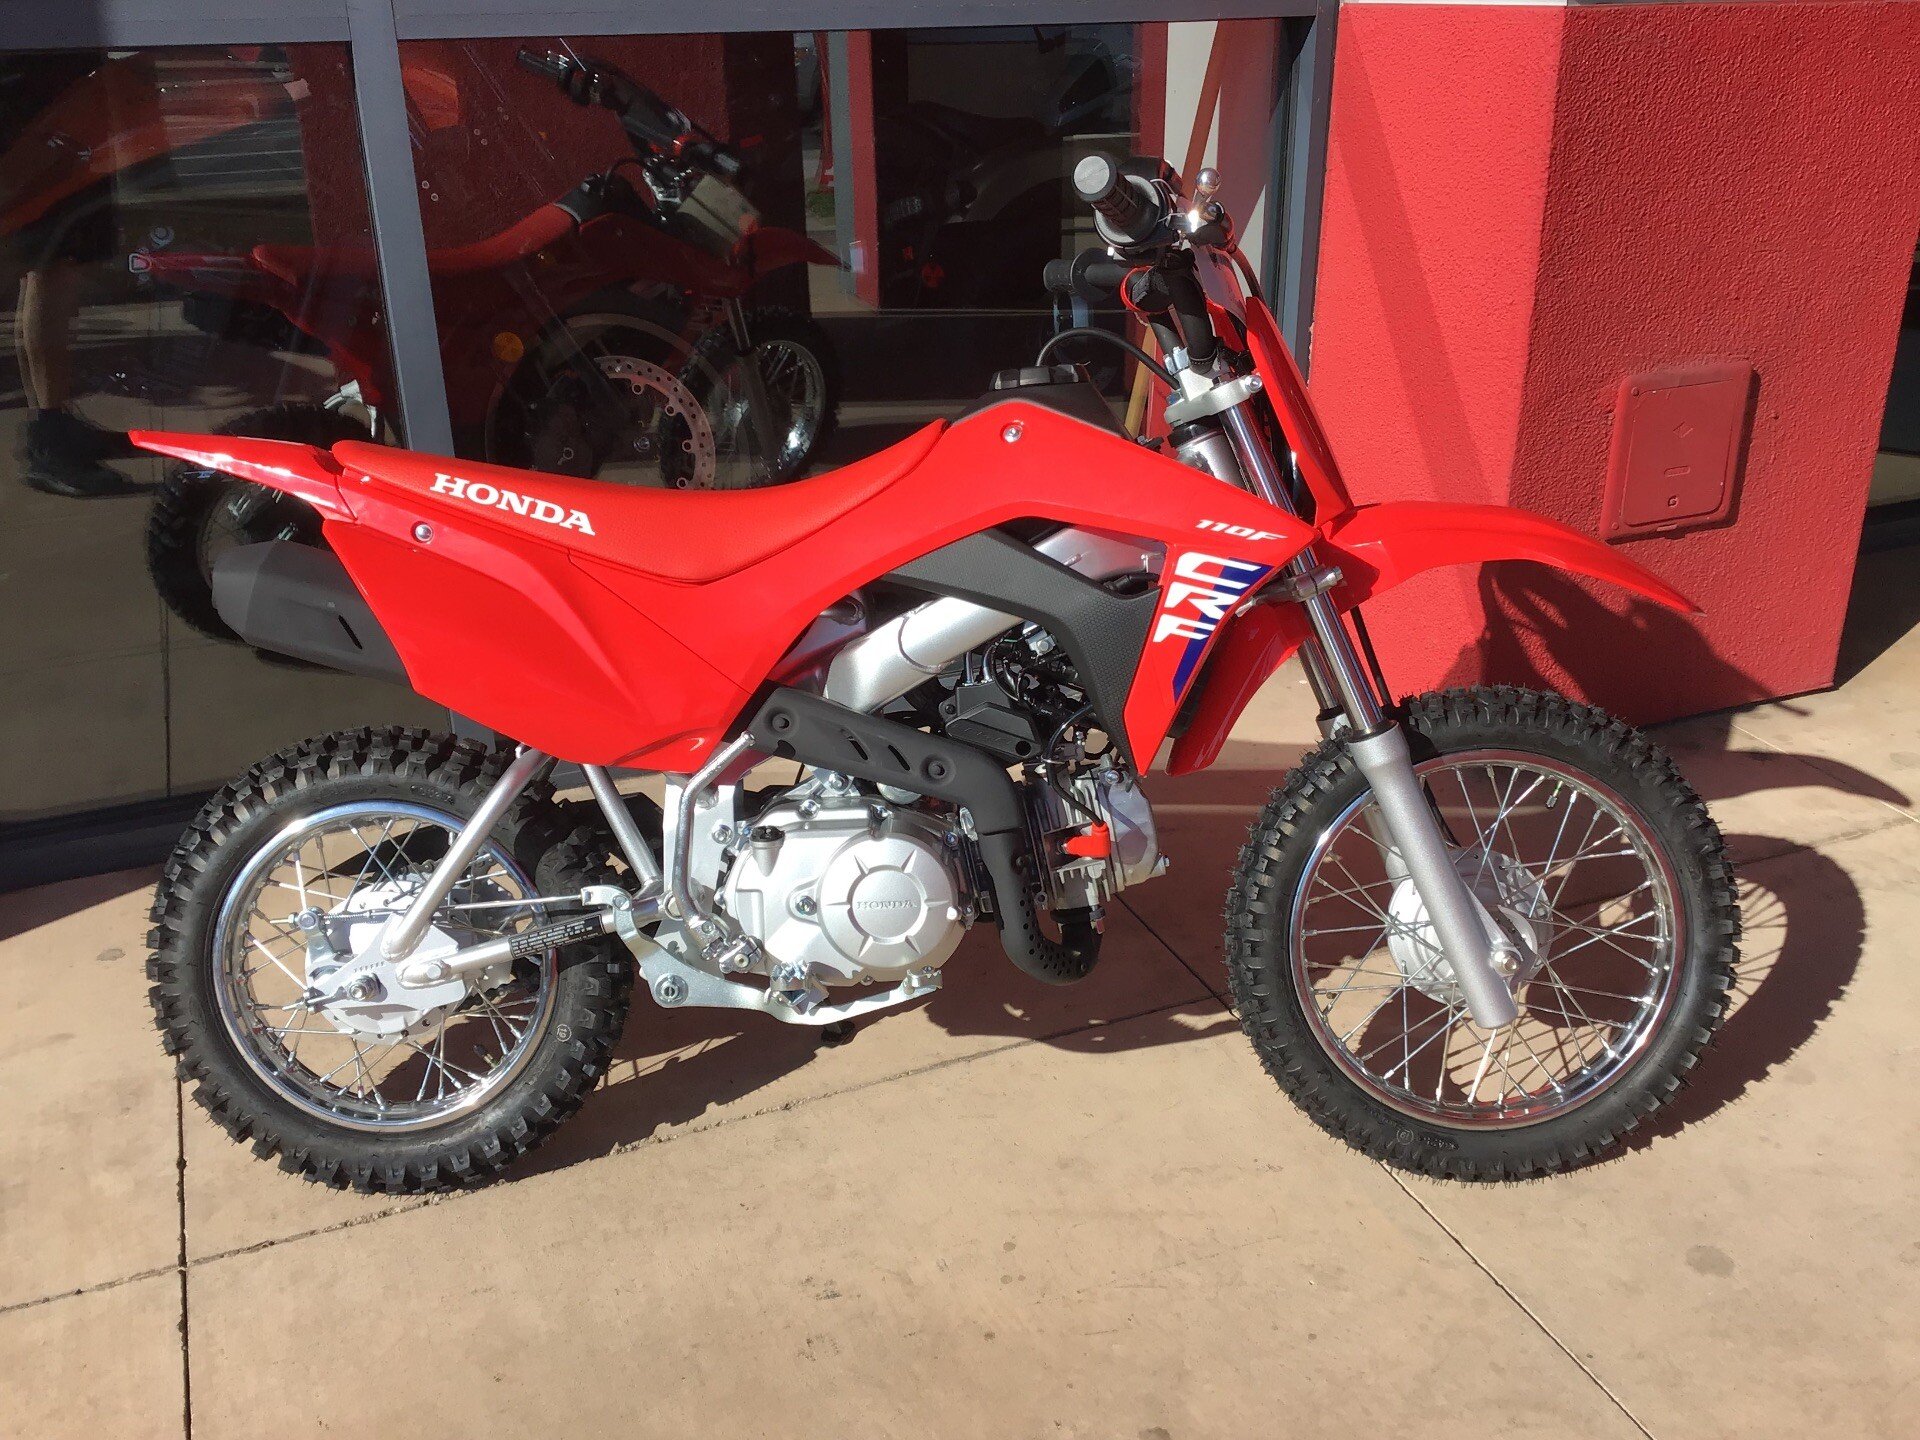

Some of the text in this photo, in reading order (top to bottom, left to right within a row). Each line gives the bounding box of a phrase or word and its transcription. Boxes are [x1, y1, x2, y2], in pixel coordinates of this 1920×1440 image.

[429, 472, 596, 536] HONDA
[1195, 519, 1289, 541] 110F
[1153, 551, 1262, 643] CRF
[857, 900, 917, 910] HONDA
